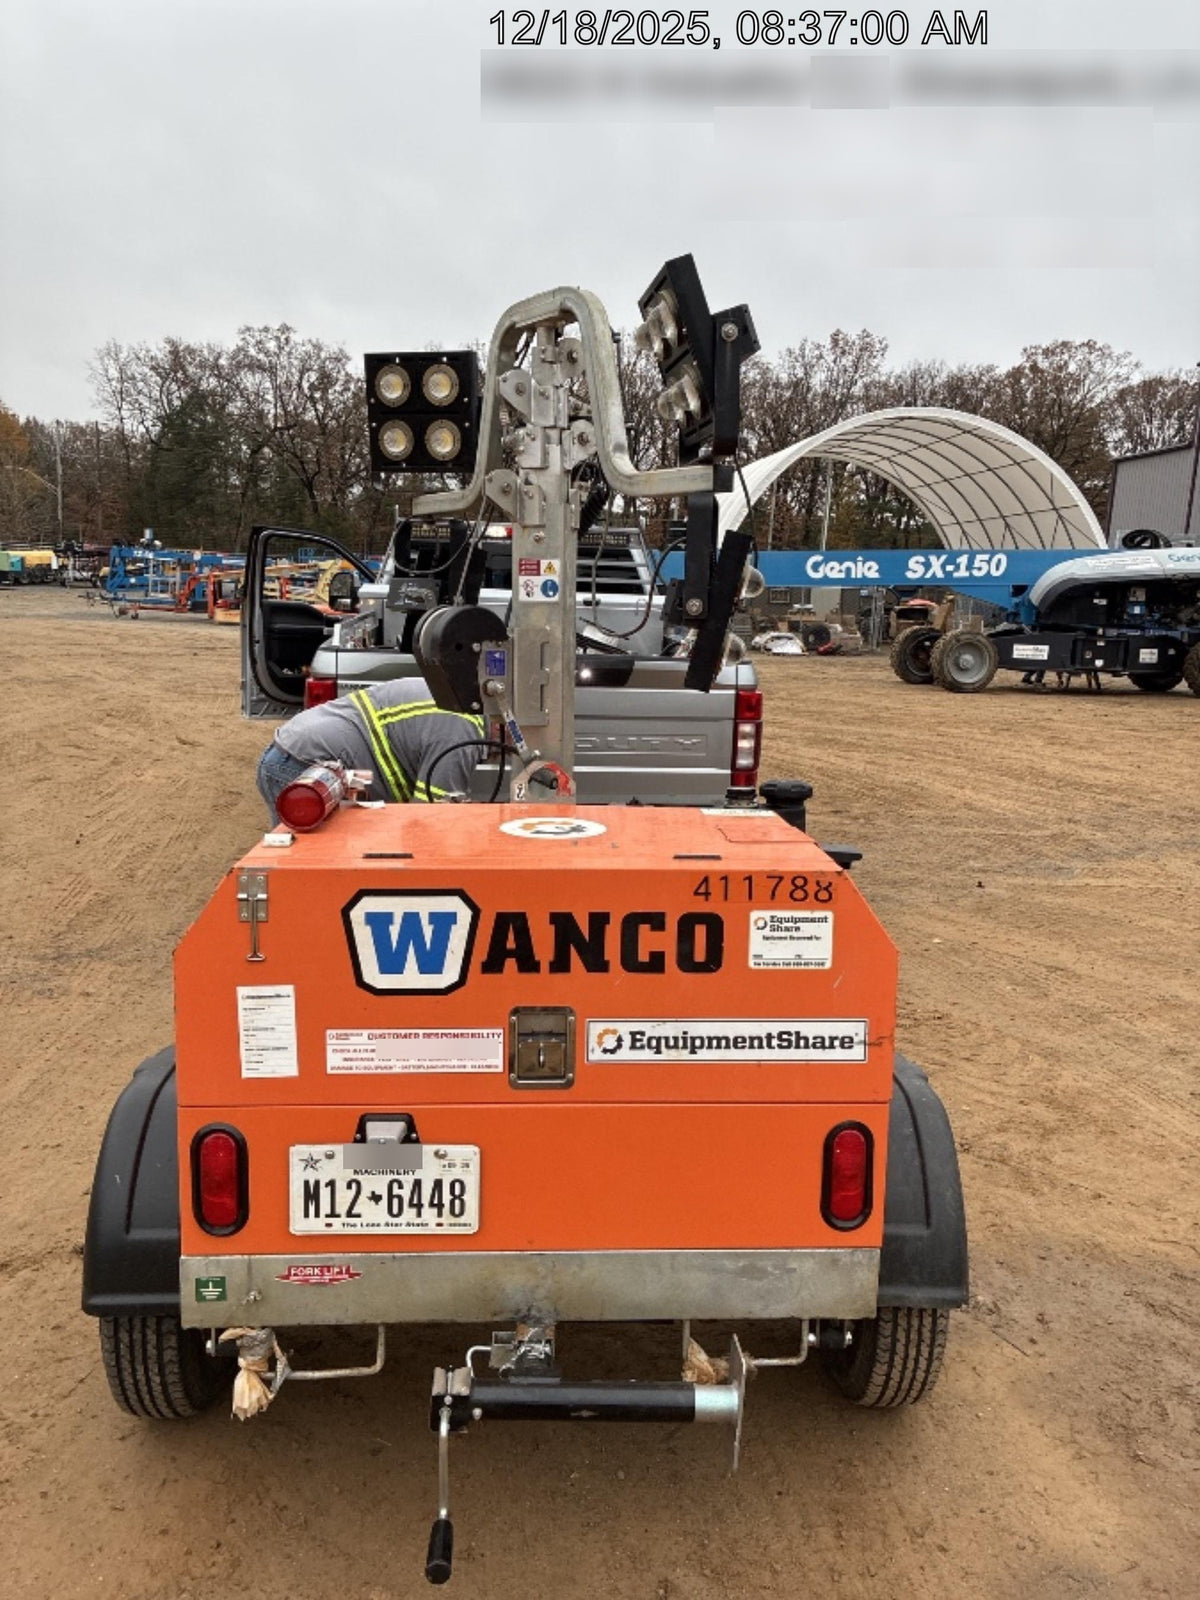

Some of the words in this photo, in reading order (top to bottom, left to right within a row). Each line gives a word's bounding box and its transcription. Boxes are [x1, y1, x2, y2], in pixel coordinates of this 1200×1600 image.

[805, 554, 880, 579] Genie
[905, 553, 1008, 579] SX-150
[693, 875, 834, 902] 411788
[769, 915, 829, 924] Equipment
[769, 924, 801, 932] Share
[364, 911, 724, 974] WANCO
[629, 1030, 854, 1054] EquipmentShare
[303, 1178, 362, 1218] M12
[387, 1178, 466, 1218] 6448
[291, 1266, 322, 1276] FORK
